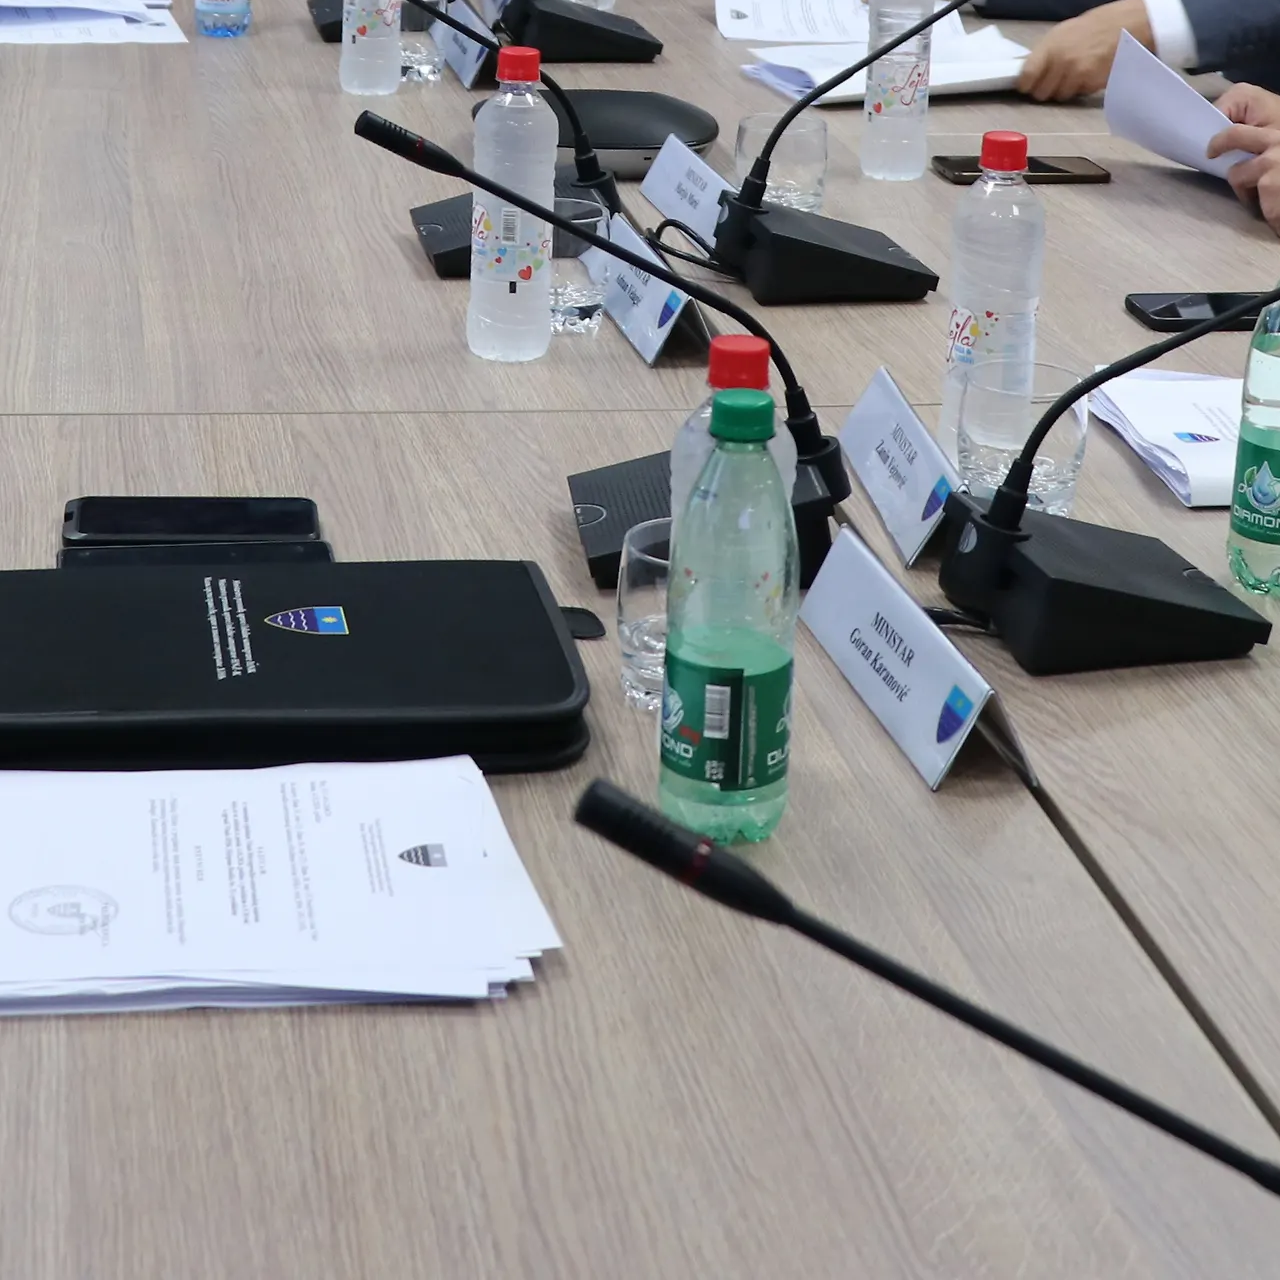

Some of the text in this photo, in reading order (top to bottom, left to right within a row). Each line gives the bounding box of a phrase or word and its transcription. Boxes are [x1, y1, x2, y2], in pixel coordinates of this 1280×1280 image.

[890, 423, 918, 466] MINISTAR
[849, 627, 911, 702] Goran Karanović
[870, 611, 915, 668] MINISTAR
